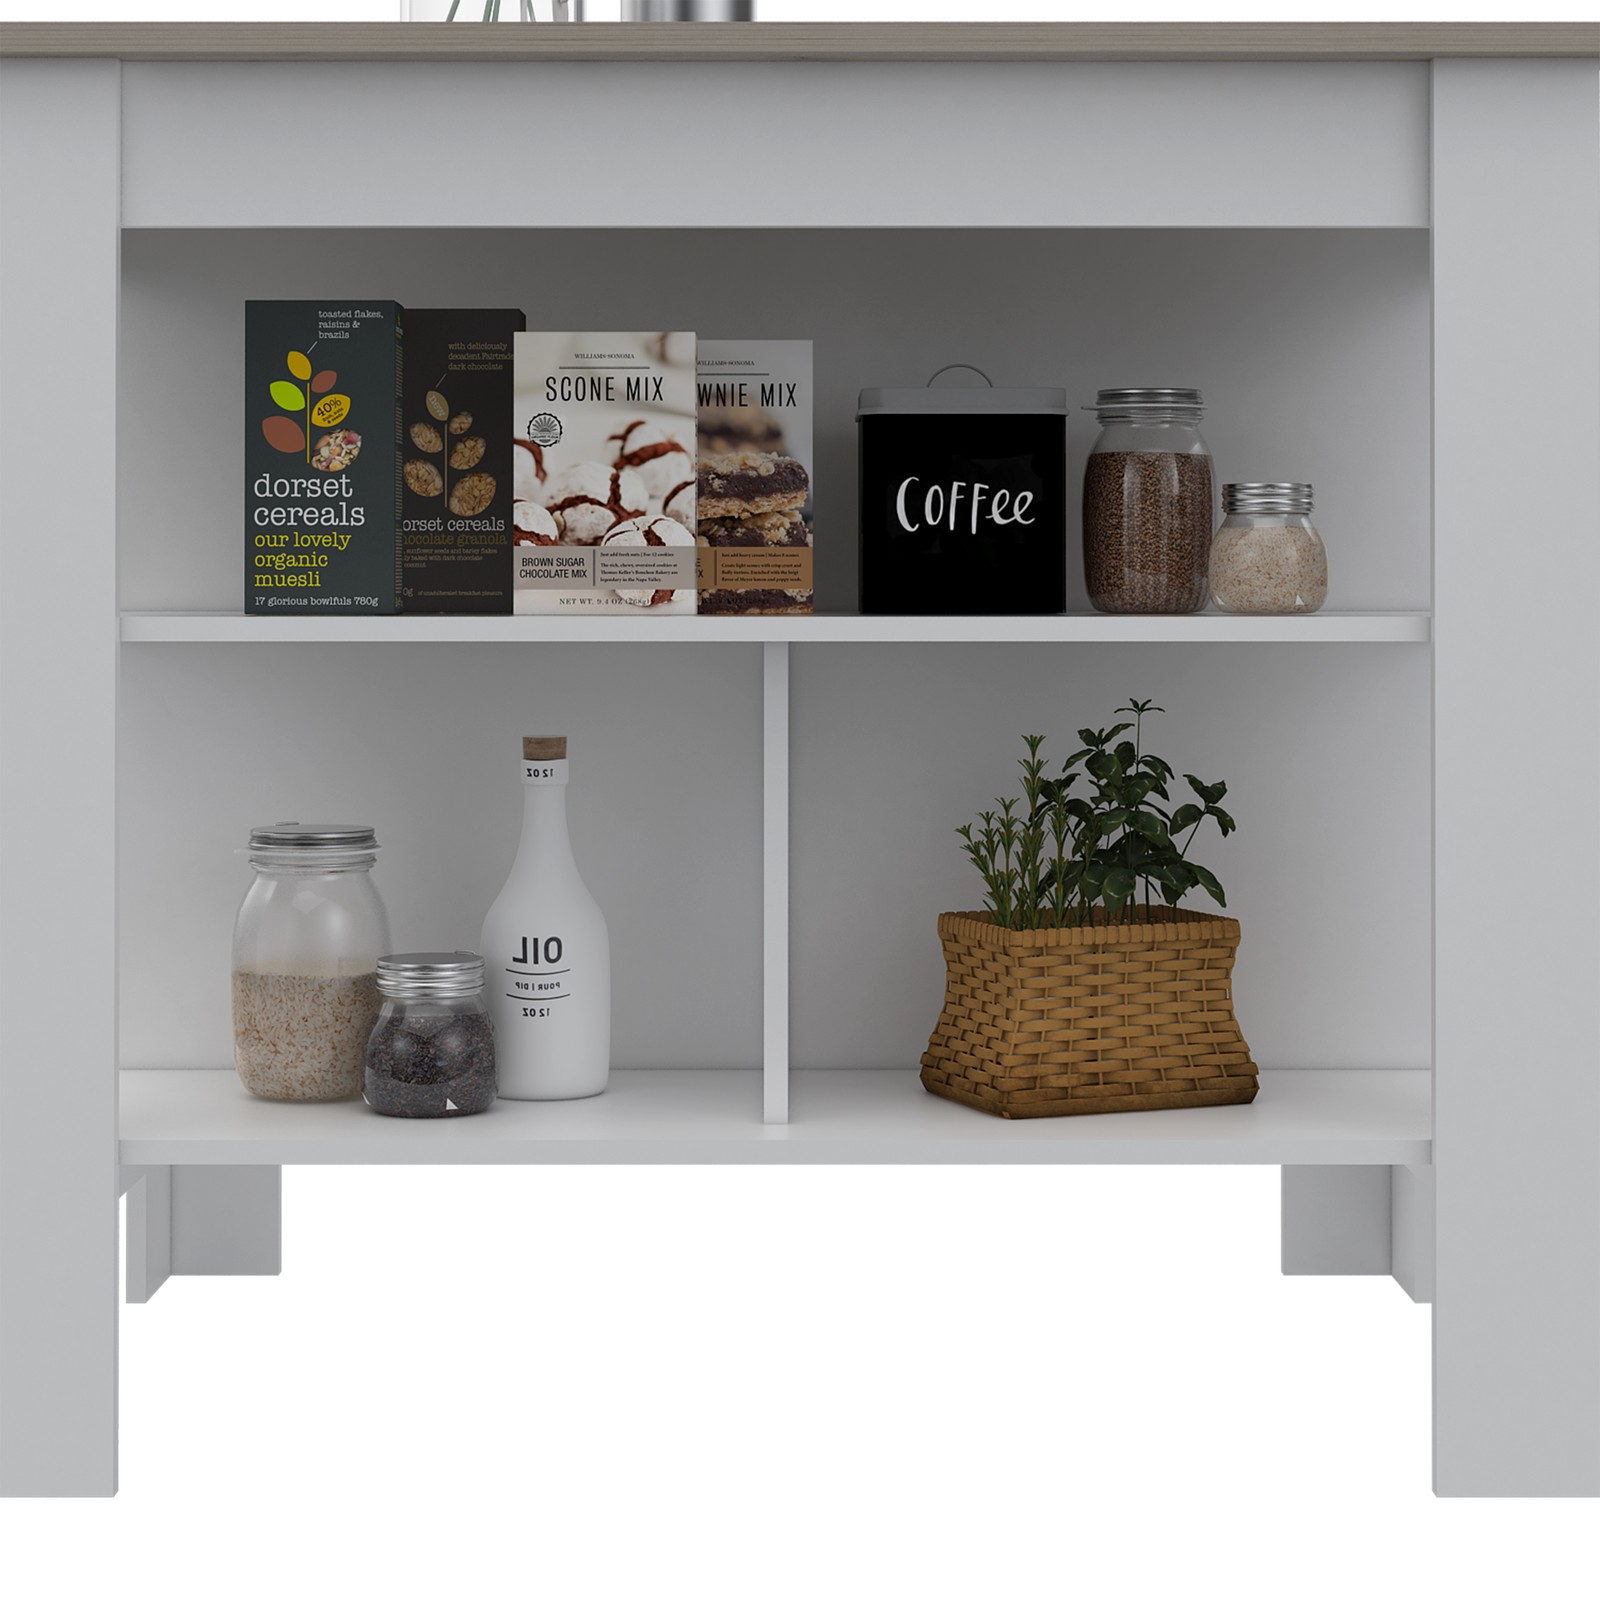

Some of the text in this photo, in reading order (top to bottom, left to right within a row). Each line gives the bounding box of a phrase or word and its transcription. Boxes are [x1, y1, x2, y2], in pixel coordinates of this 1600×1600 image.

[319, 310, 384, 319] toasted flakes,
[319, 321, 360, 329] raisins &
[319, 331, 350, 339] brazils
[448, 342, 465, 351] with
[546, 376, 664, 402] SCONE MIX
[697, 383, 797, 407] WNIE MIX
[318, 397, 342, 416] 40%
[254, 473, 353, 498] dorset
[254, 502, 366, 526] cereals
[403, 517, 505, 532] orset cereals
[255, 532, 352, 551] our lovely
[403, 533, 508, 547] ocolate granola
[255, 552, 329, 570] organic
[522, 558, 585, 567] BROWN SUGAR
[255, 571, 321, 587] muesli
[520, 569, 588, 578] CHOCOLATE MIX
[403, 587, 414, 597] 0g
[255, 597, 379, 607] 17 glorious bowlfuls 780g
